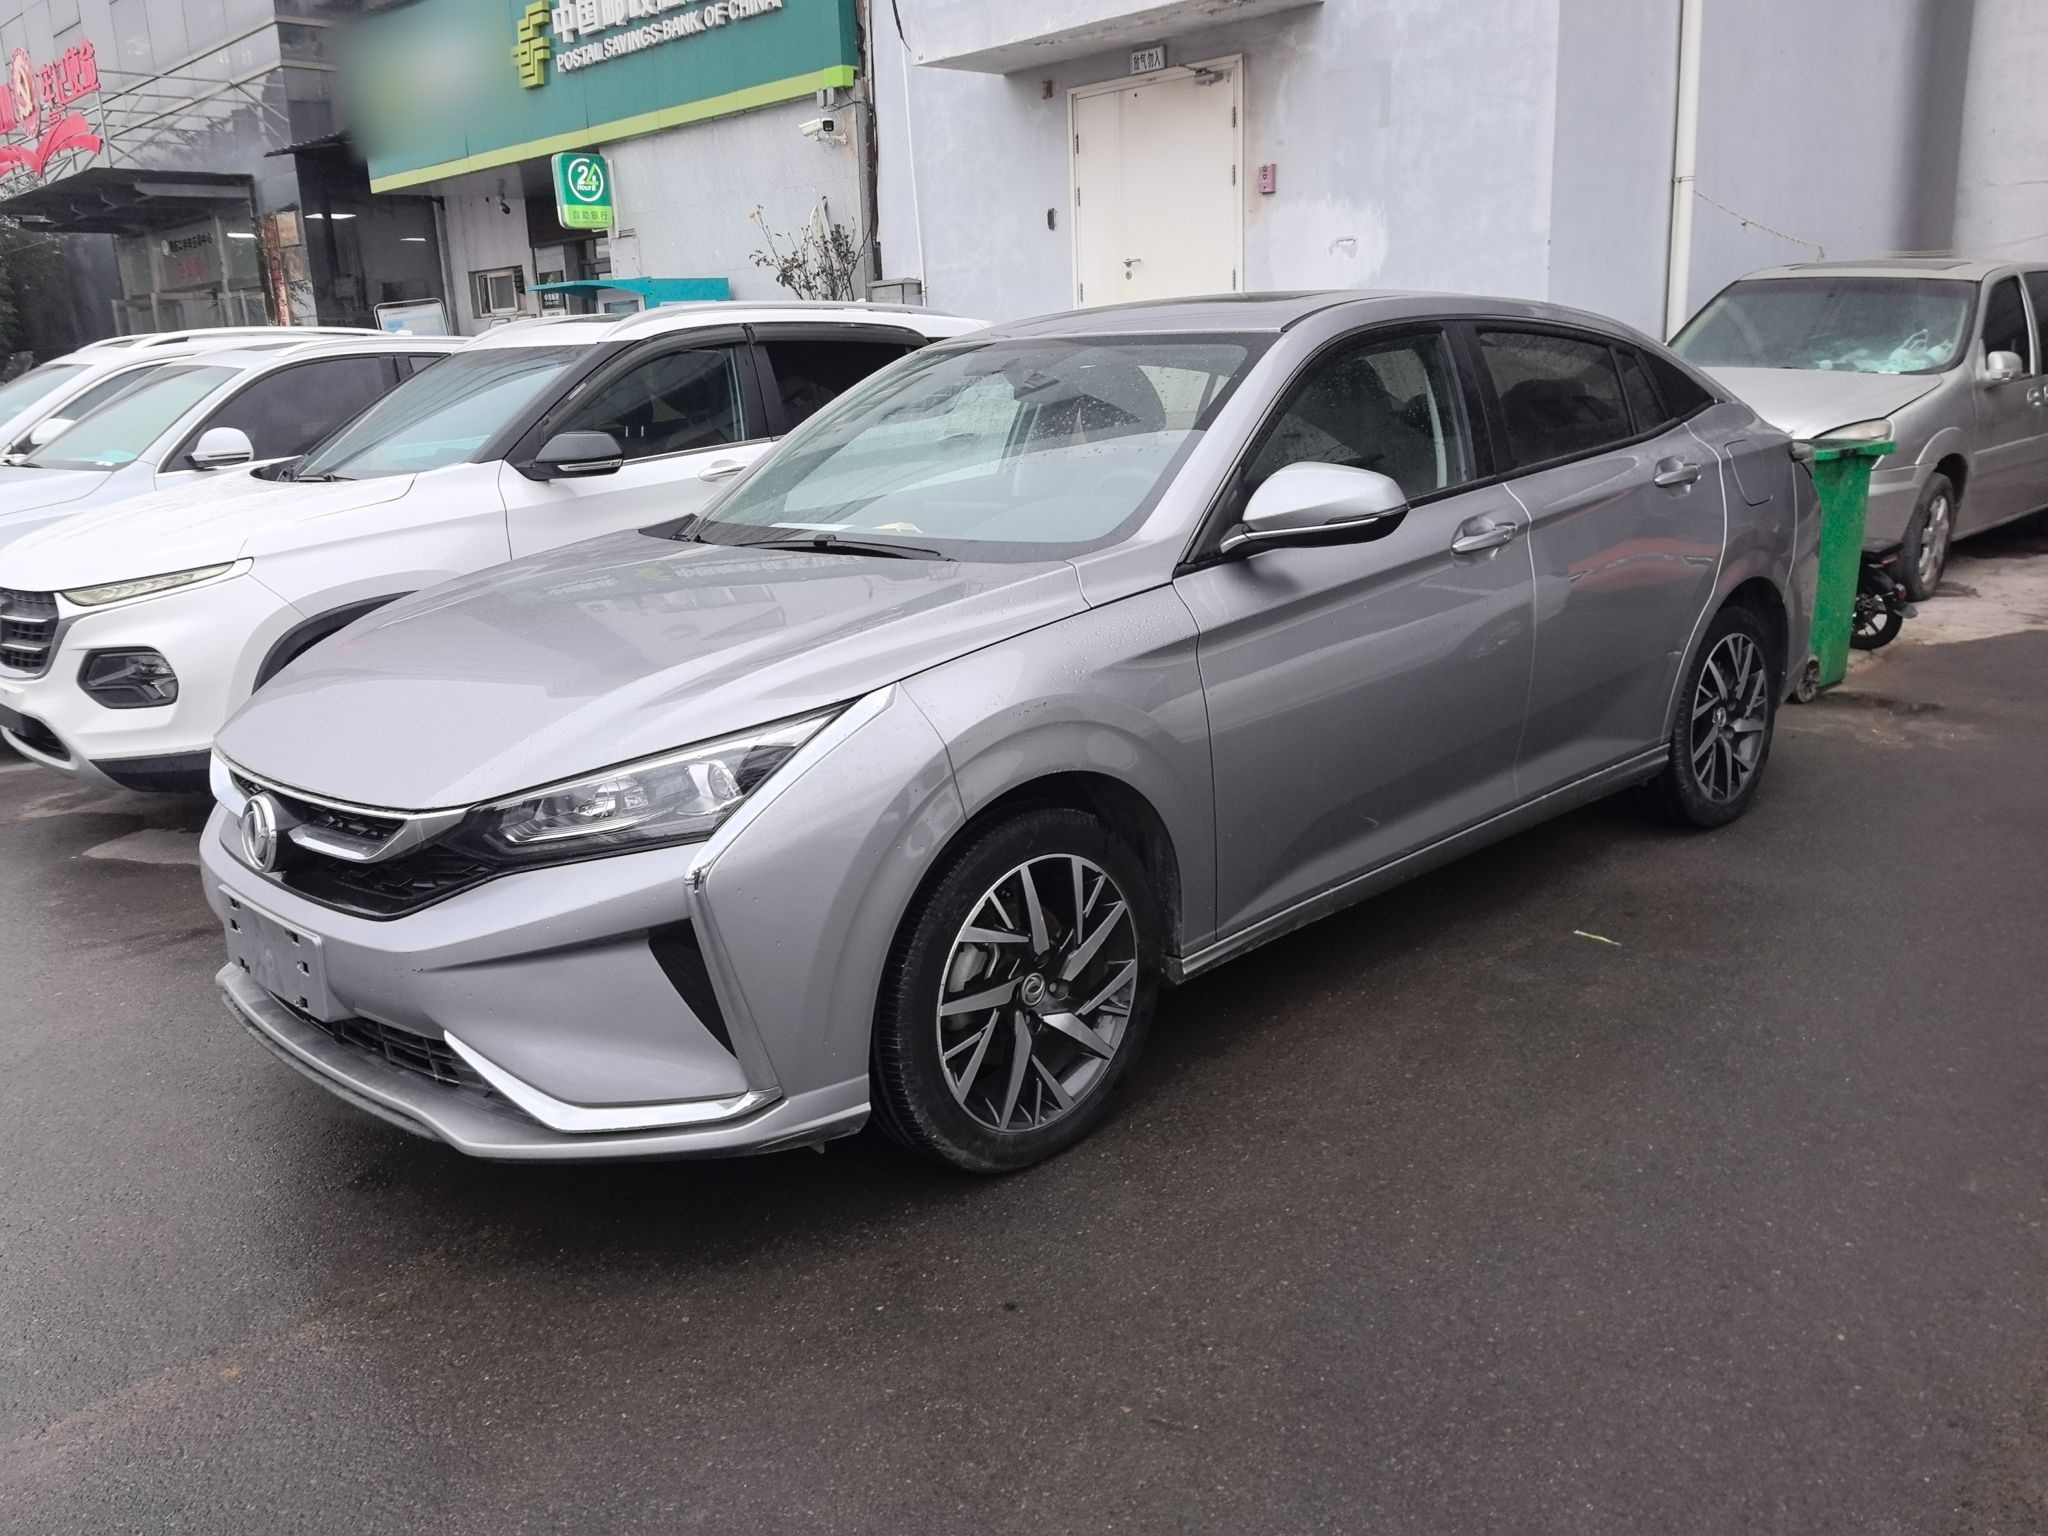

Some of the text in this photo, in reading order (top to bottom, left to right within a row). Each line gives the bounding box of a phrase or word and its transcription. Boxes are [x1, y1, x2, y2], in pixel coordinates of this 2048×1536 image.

[556, 0, 782, 72] POSTAL SAVINGS BANK OF CHINA
[577, 163, 599, 191] 24
[573, 210, 608, 220] 自助银行
